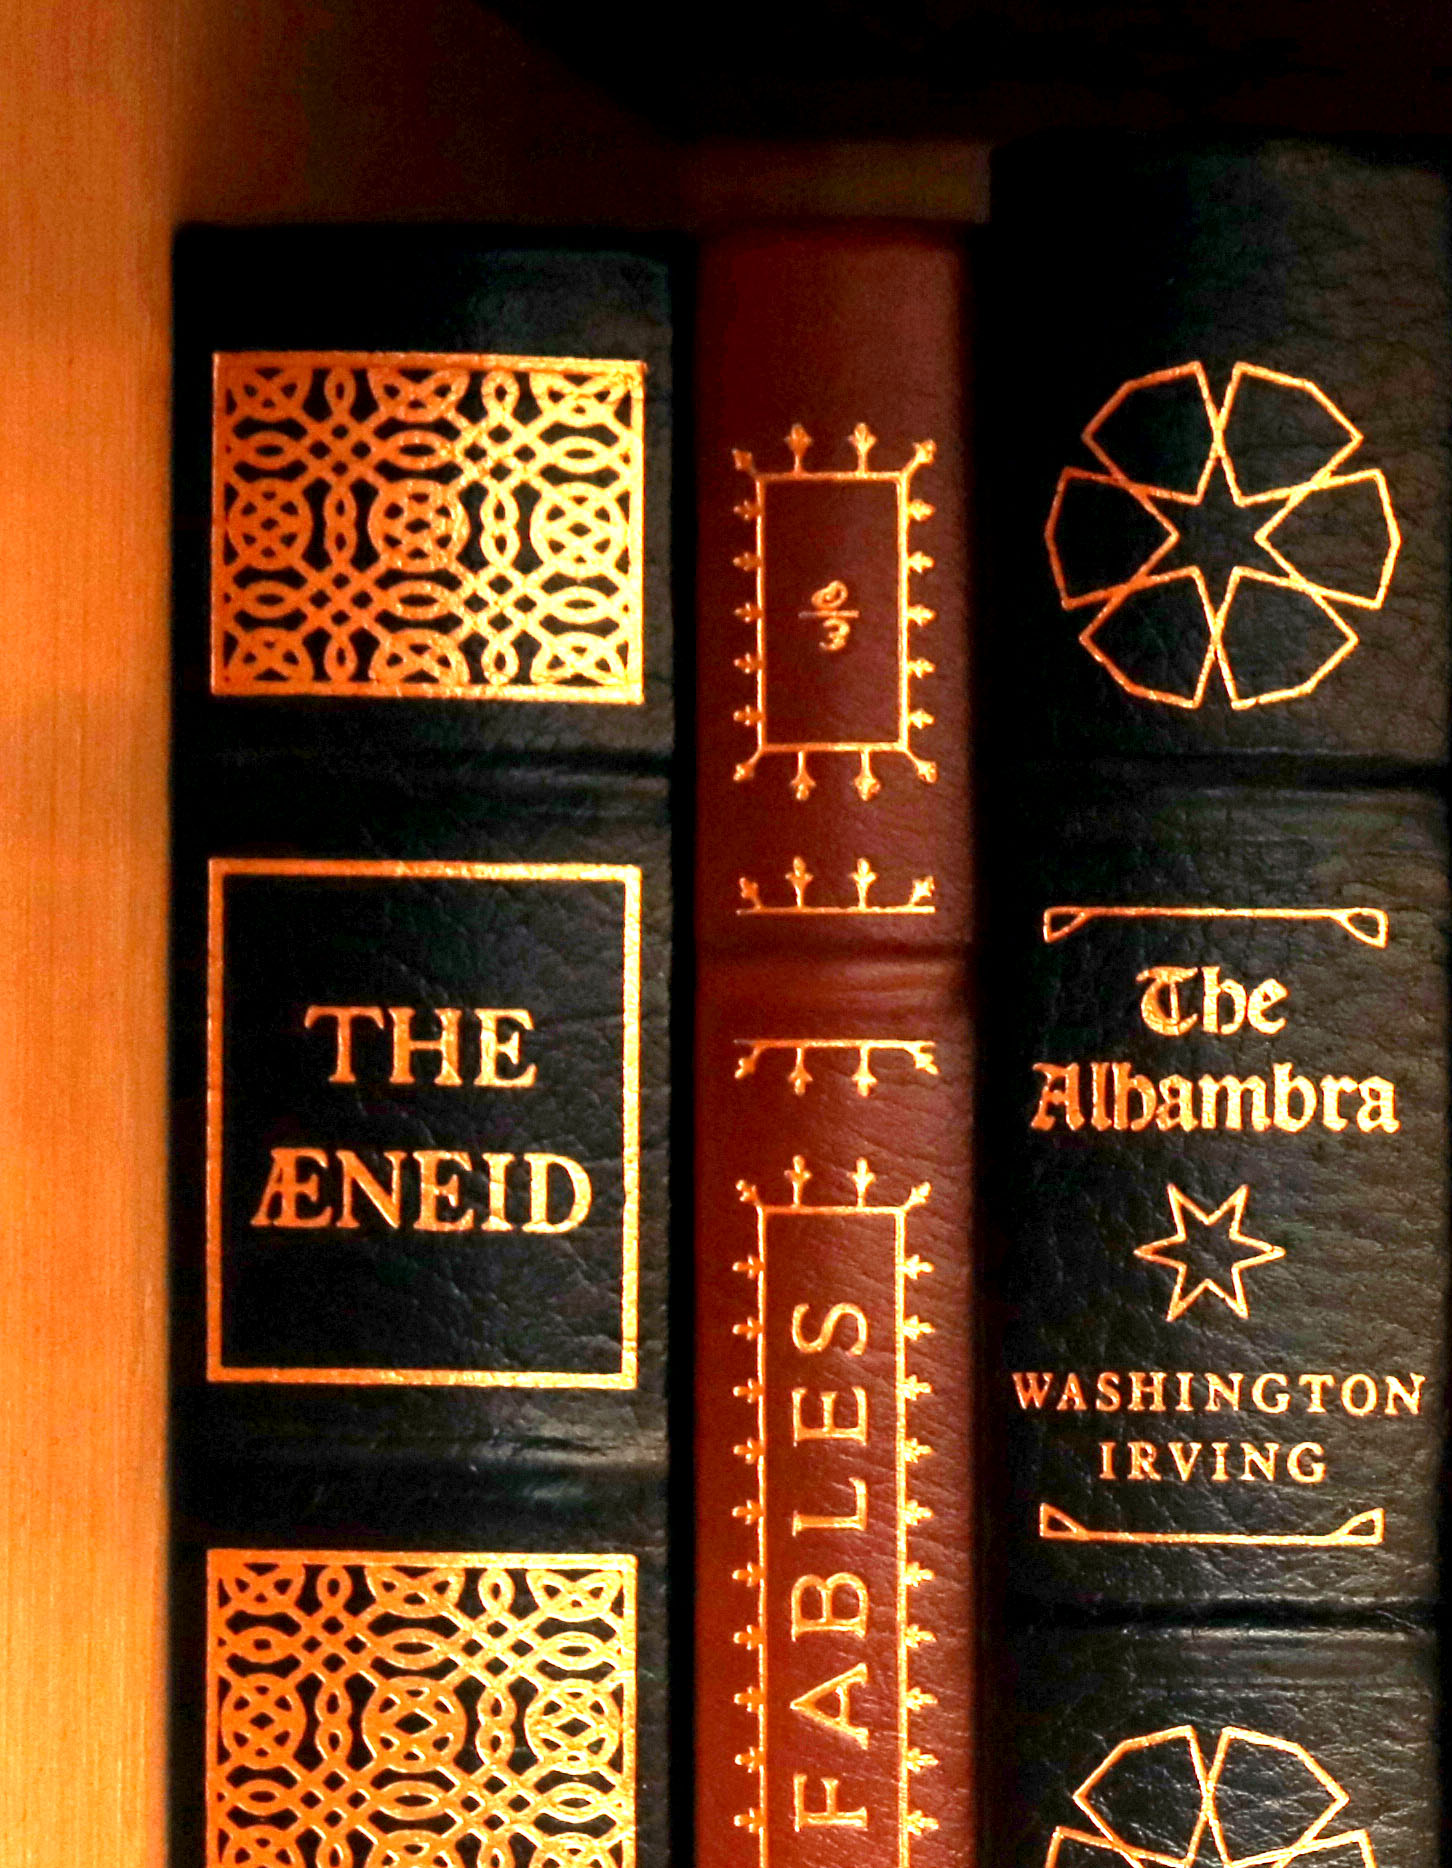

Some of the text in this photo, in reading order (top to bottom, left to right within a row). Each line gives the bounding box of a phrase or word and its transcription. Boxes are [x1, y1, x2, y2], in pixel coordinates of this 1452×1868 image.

[1134, 964, 1290, 1038] The
[302, 1005, 539, 1091] THE
[1028, 1059, 1402, 1136] Alhambra
[253, 1148, 594, 1236] ÆNEID
[1014, 1369, 1428, 1419] WASHINGTON
[1097, 1439, 1328, 1486] IRVING
[787, 1300, 872, 1835] FABLES
